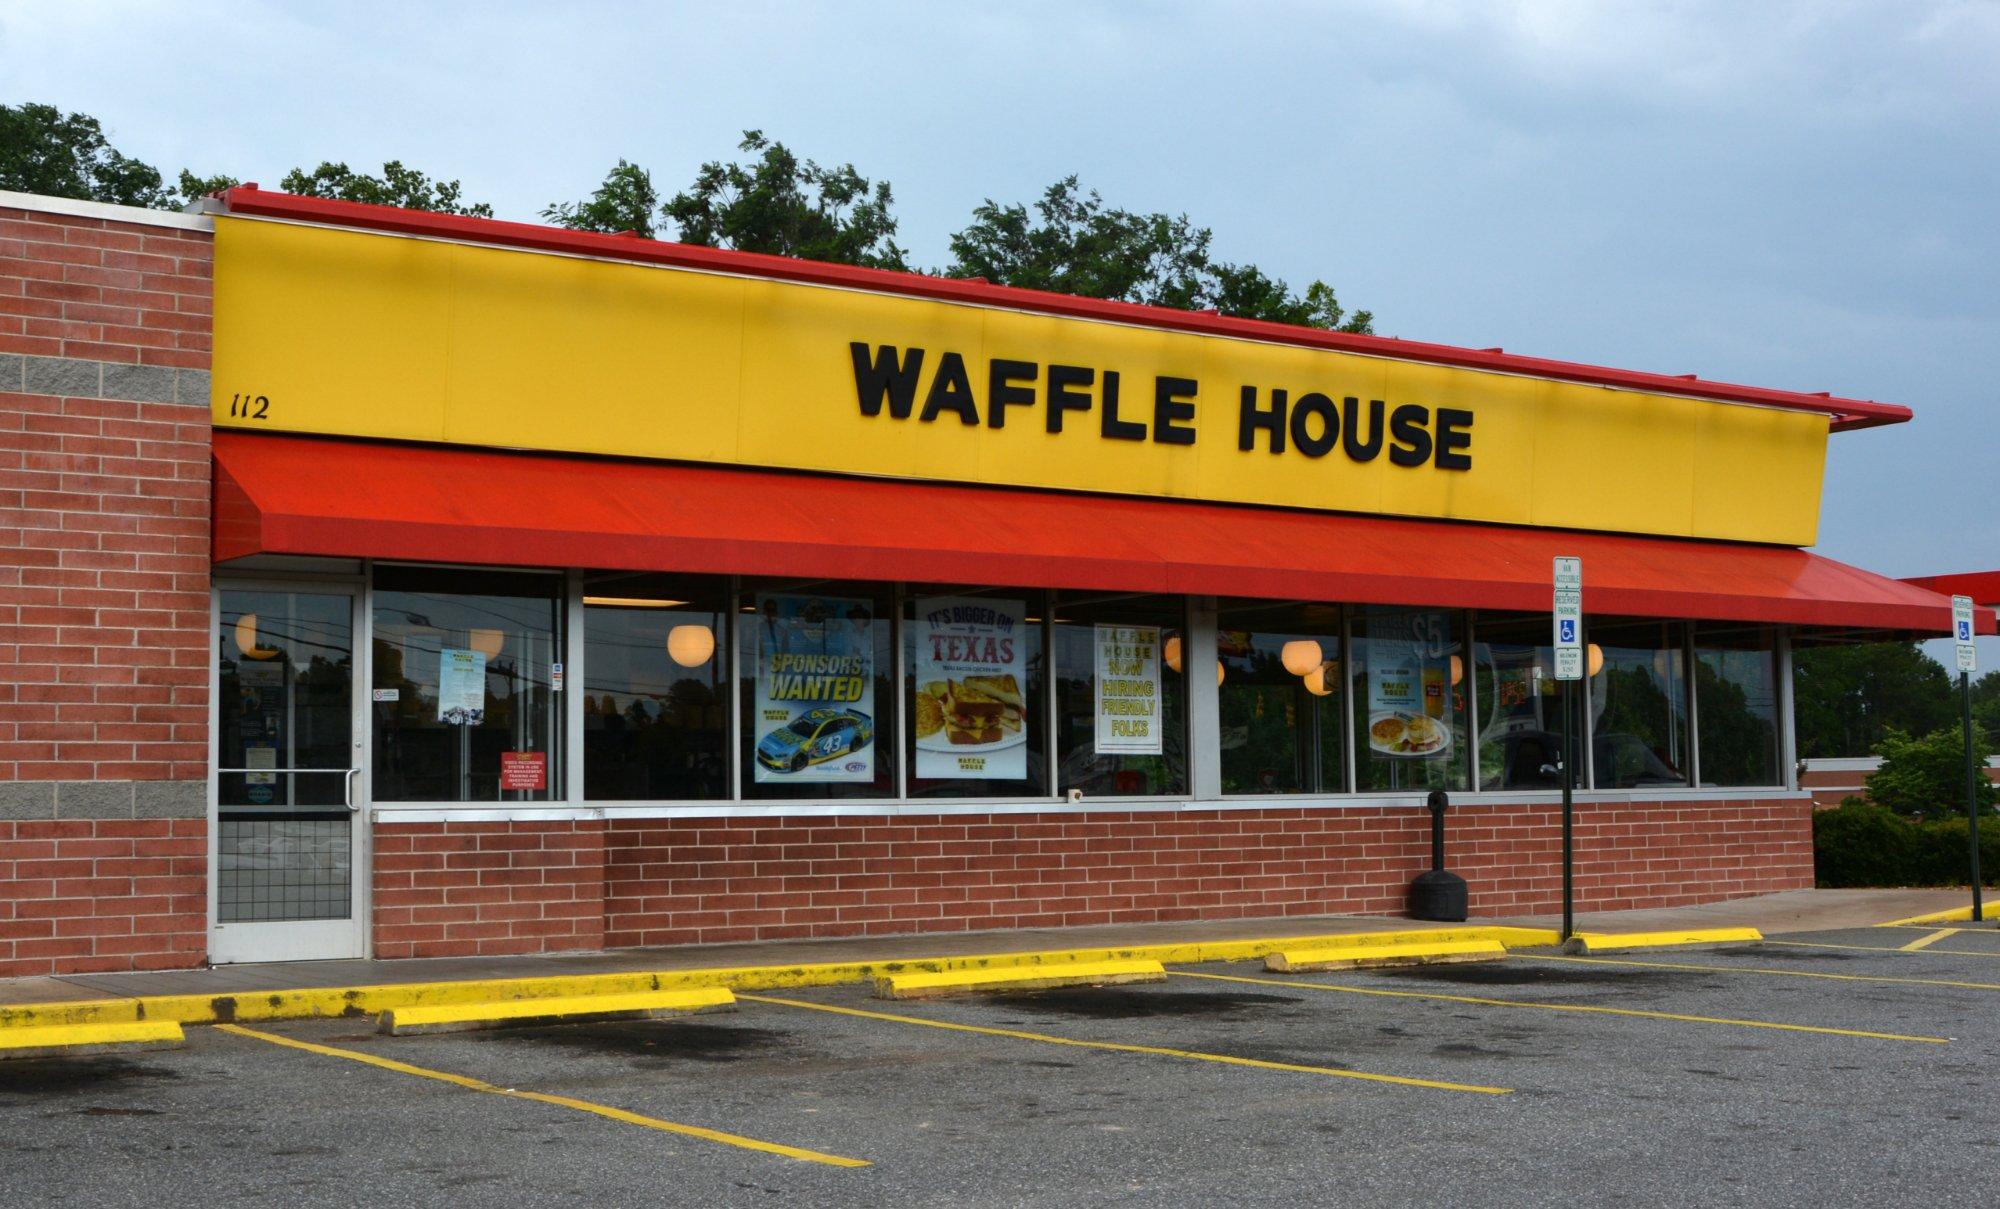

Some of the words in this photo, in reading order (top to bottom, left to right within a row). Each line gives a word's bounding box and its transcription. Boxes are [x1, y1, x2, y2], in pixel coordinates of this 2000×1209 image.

[231, 393, 270, 420] 112
[850, 342, 1198, 446] WAFFLE
[1238, 385, 1474, 471] HOUSE
[1555, 596, 1579, 604] RESERVED
[928, 608, 951, 630] IT'S
[953, 606, 995, 625] BIGGER
[996, 613, 1015, 633] ON
[1557, 607, 1577, 615] PARKING
[1101, 630, 1156, 642] WAFFLE
[928, 634, 1015, 664] TEXAS
[1104, 645, 1153, 658] HOUSE
[770, 653, 864, 675] SPONSORS
[1108, 659, 1144, 676] NOW
[768, 675, 864, 701] WANTED
[1102, 680, 1154, 697] HIRING
[1101, 699, 1155, 716] FRIENDLY
[1111, 720, 1149, 737] FOLKS
[823, 735, 842, 753] 43
